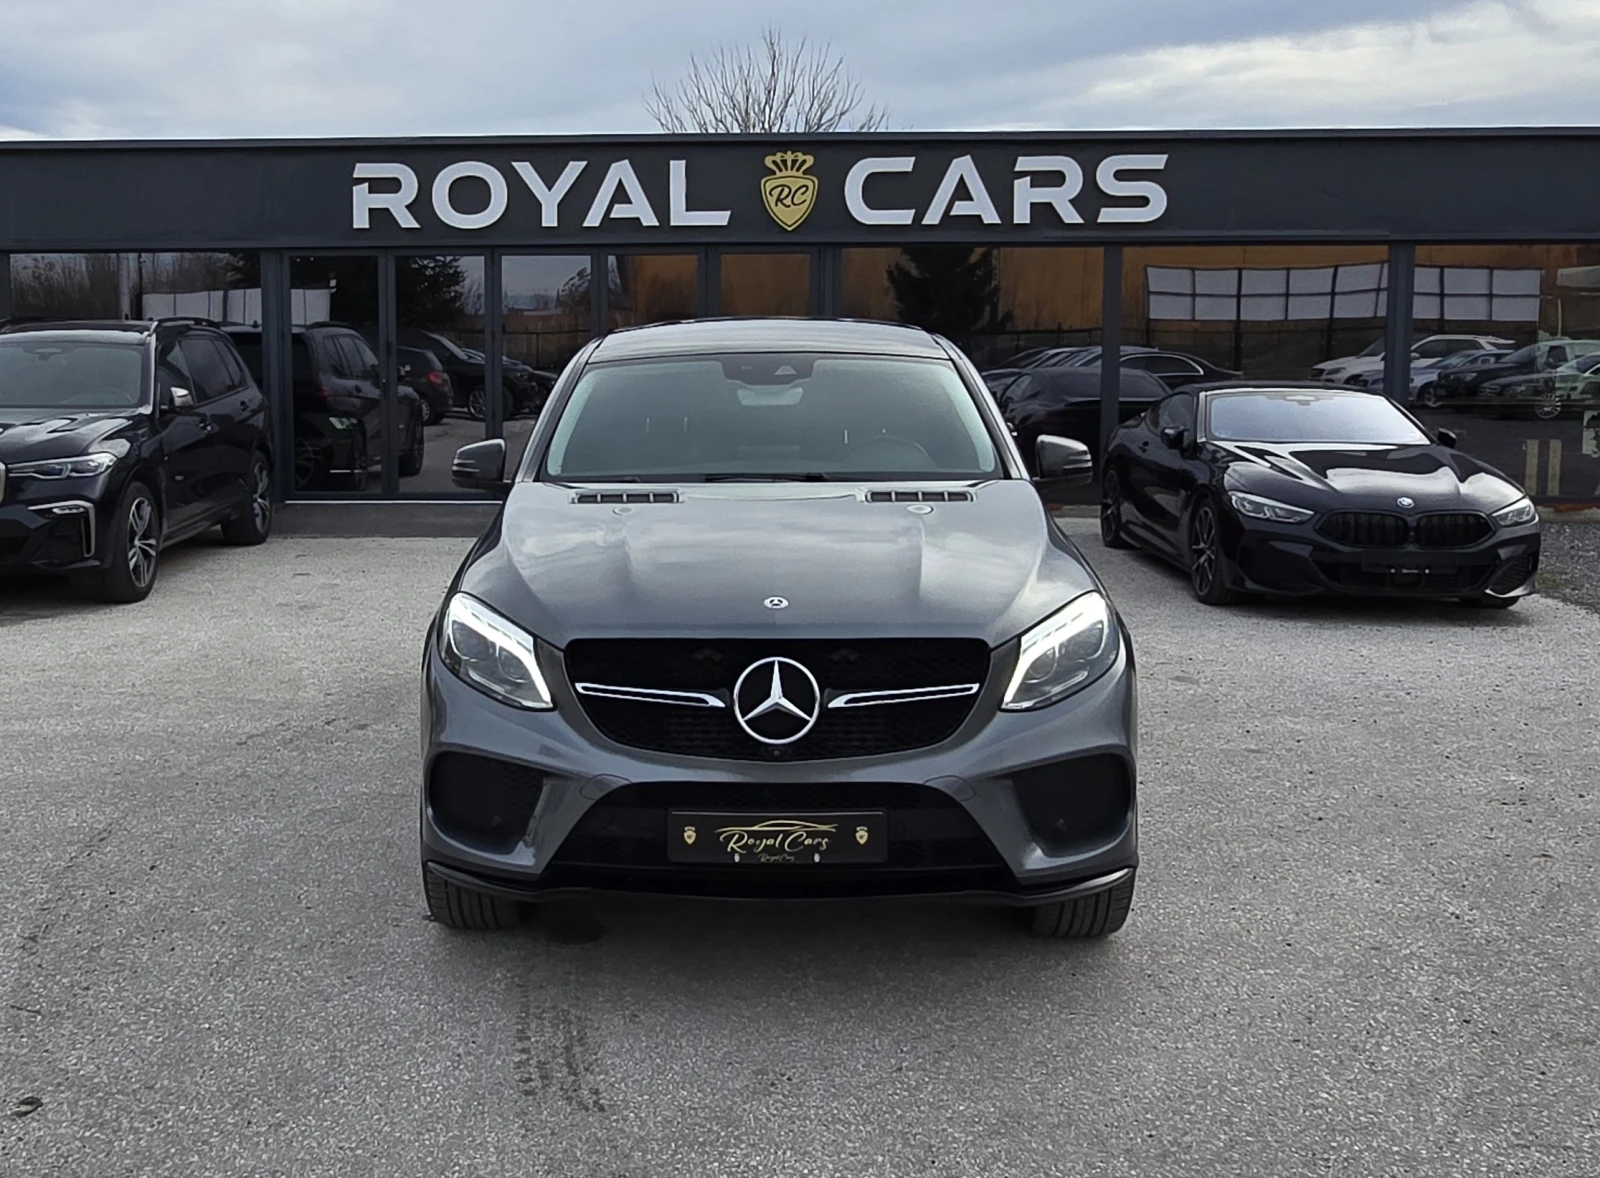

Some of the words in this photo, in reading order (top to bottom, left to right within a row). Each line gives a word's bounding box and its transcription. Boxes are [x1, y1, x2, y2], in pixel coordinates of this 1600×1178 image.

[352, 158, 732, 230] ROYAL
[844, 154, 1169, 225] CARS
[768, 183, 810, 209] RC
[719, 830, 784, 854] Royal
[784, 831, 829, 852] Cars
